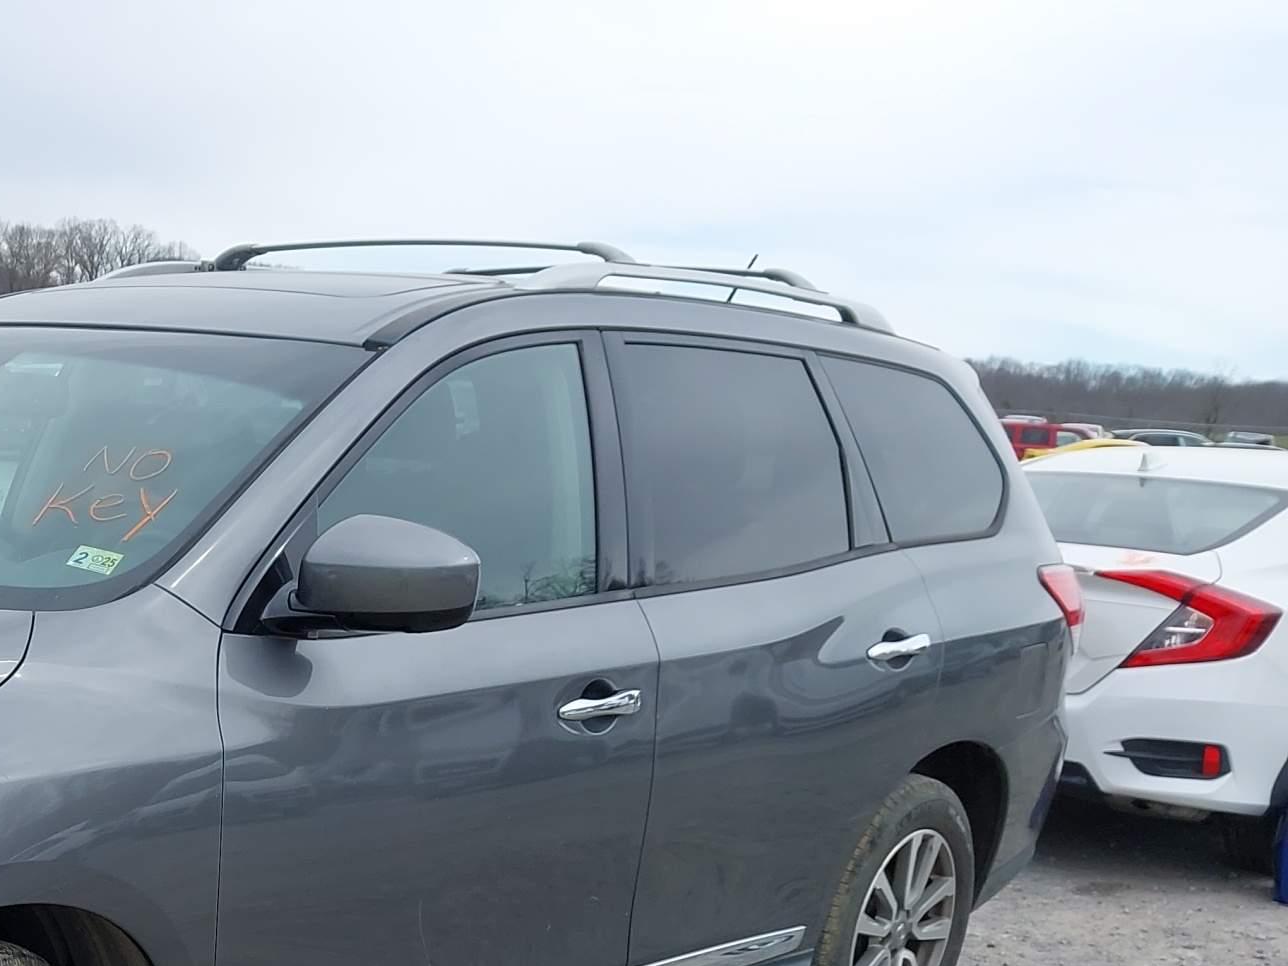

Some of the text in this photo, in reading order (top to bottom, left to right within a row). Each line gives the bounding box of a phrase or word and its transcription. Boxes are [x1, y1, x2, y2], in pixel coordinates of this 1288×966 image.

[83, 445, 173, 481] NO
[72, 551, 118, 568] 2 25
